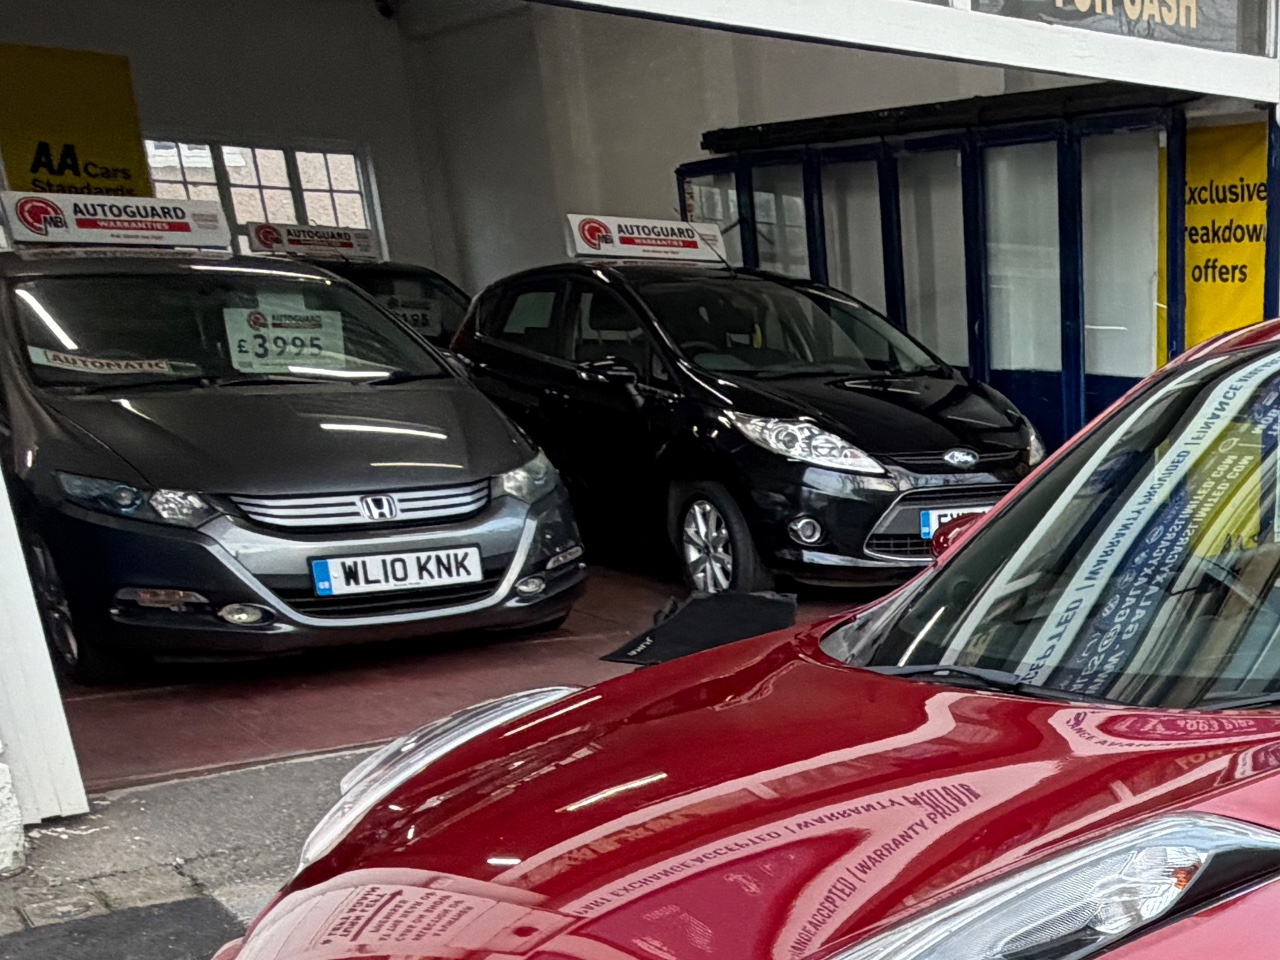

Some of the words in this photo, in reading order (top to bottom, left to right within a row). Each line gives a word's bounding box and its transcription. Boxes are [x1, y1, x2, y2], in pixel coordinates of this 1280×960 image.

[30, 141, 80, 176] AA
[83, 161, 131, 181] Cars
[1184, 177, 1267, 205] xclusive
[73, 203, 186, 220] AUTOGUARD
[96, 220, 170, 230] WARRANTIES
[286, 229, 351, 240] AUTOGUARD
[617, 223, 695, 239] AUTOGUARD
[1191, 258, 1248, 283] offers
[51, 353, 166, 370] AUTOMATIC
[340, 557, 409, 587] WL10
[416, 552, 472, 580] KNK
[857, 819, 927, 877] WARRANTY
